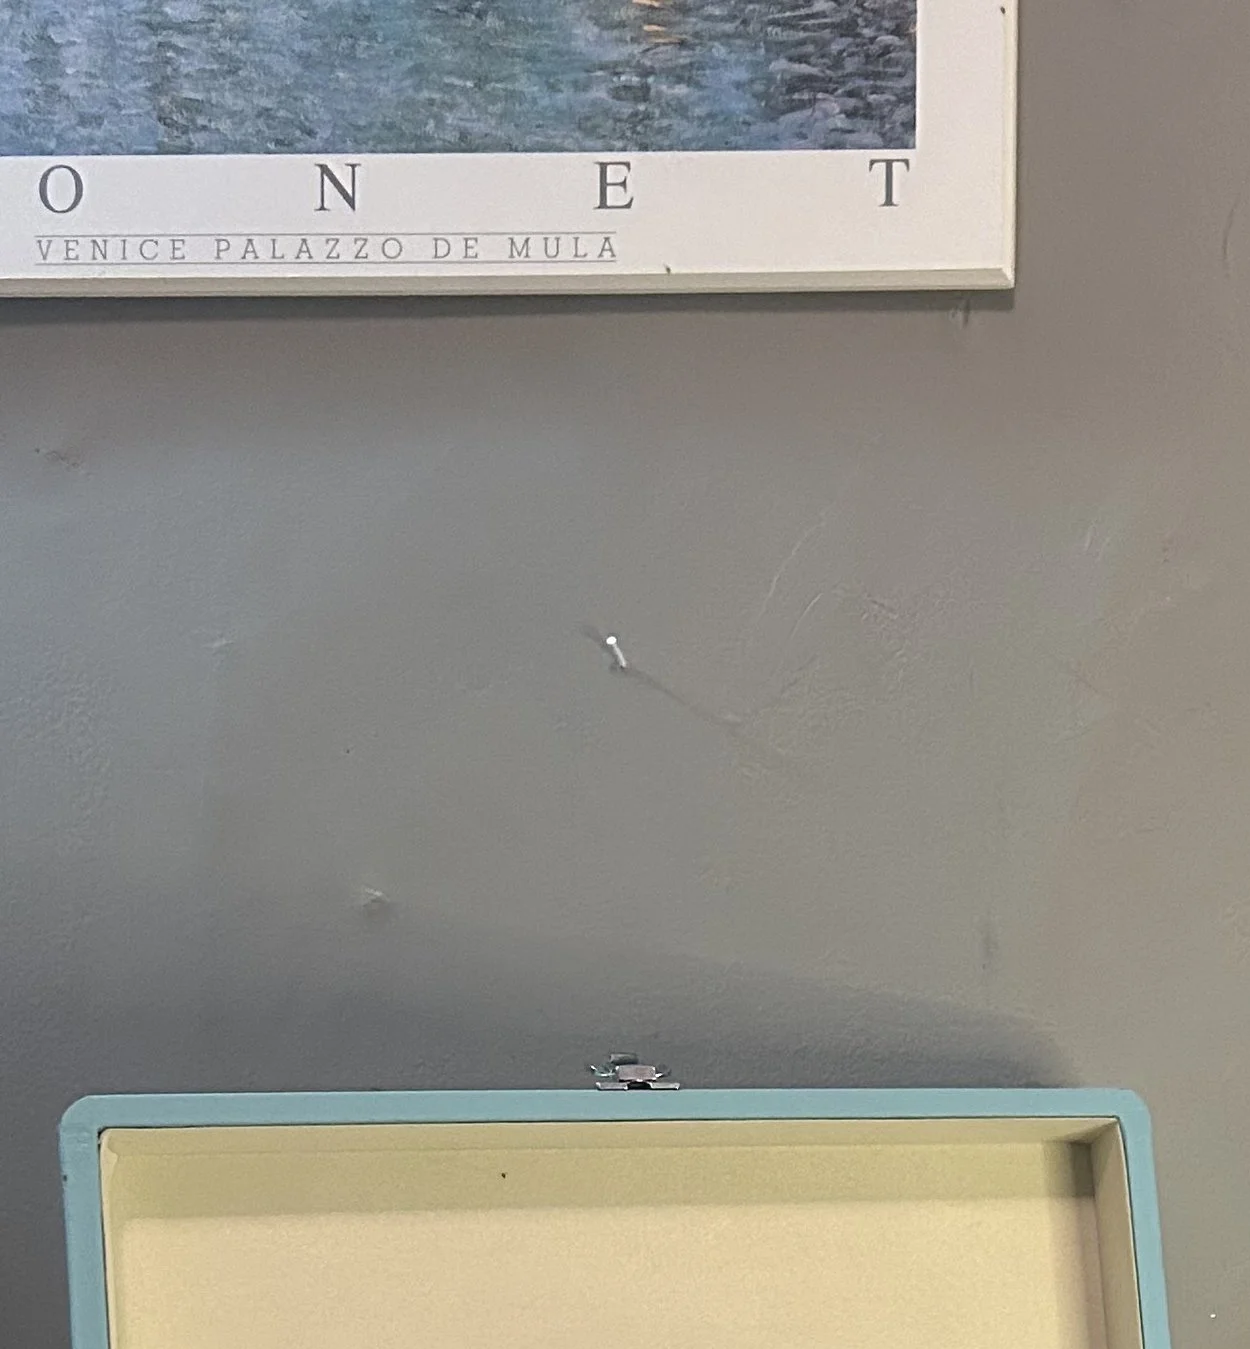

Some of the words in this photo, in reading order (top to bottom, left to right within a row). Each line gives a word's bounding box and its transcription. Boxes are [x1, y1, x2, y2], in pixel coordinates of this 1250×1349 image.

[36, 238, 187, 262] VENICE
[214, 237, 404, 261] PALAZZO
[432, 236, 480, 260] DE
[508, 235, 617, 260] MULA
